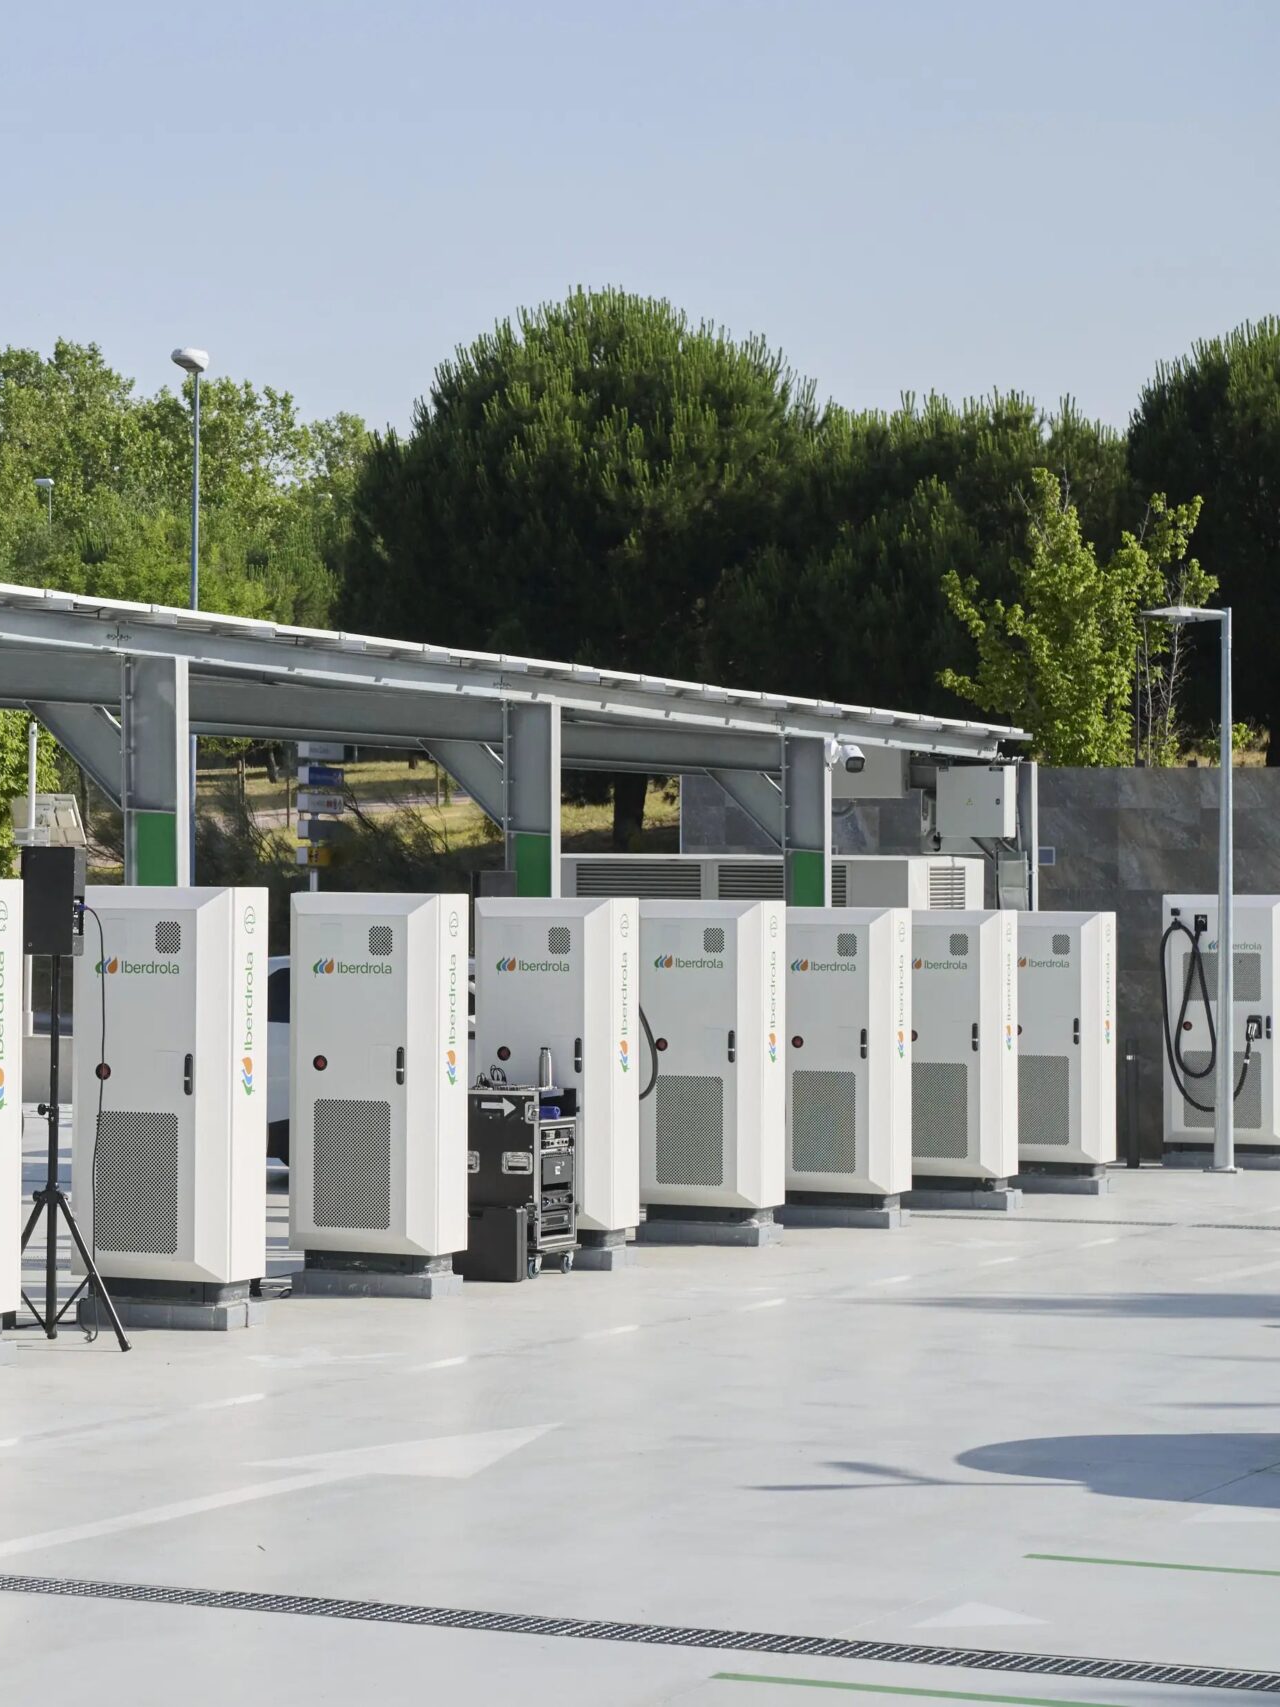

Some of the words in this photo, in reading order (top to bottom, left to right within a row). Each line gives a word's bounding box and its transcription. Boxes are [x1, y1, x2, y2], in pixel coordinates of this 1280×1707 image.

[1230, 942, 1262, 951] erdrola
[122, 961, 179, 974] Iberdrola
[337, 962, 392, 974] Iberdrola
[519, 960, 570, 972] Iberdrola
[675, 957, 723, 969] Iberdrola
[811, 961, 856, 971] Iberdrola
[924, 959, 967, 970] Iberdrola
[1028, 958, 1070, 968] Iberdrola
[243, 952, 254, 1050] Iberdrola
[448, 954, 456, 1044] Iberdrola
